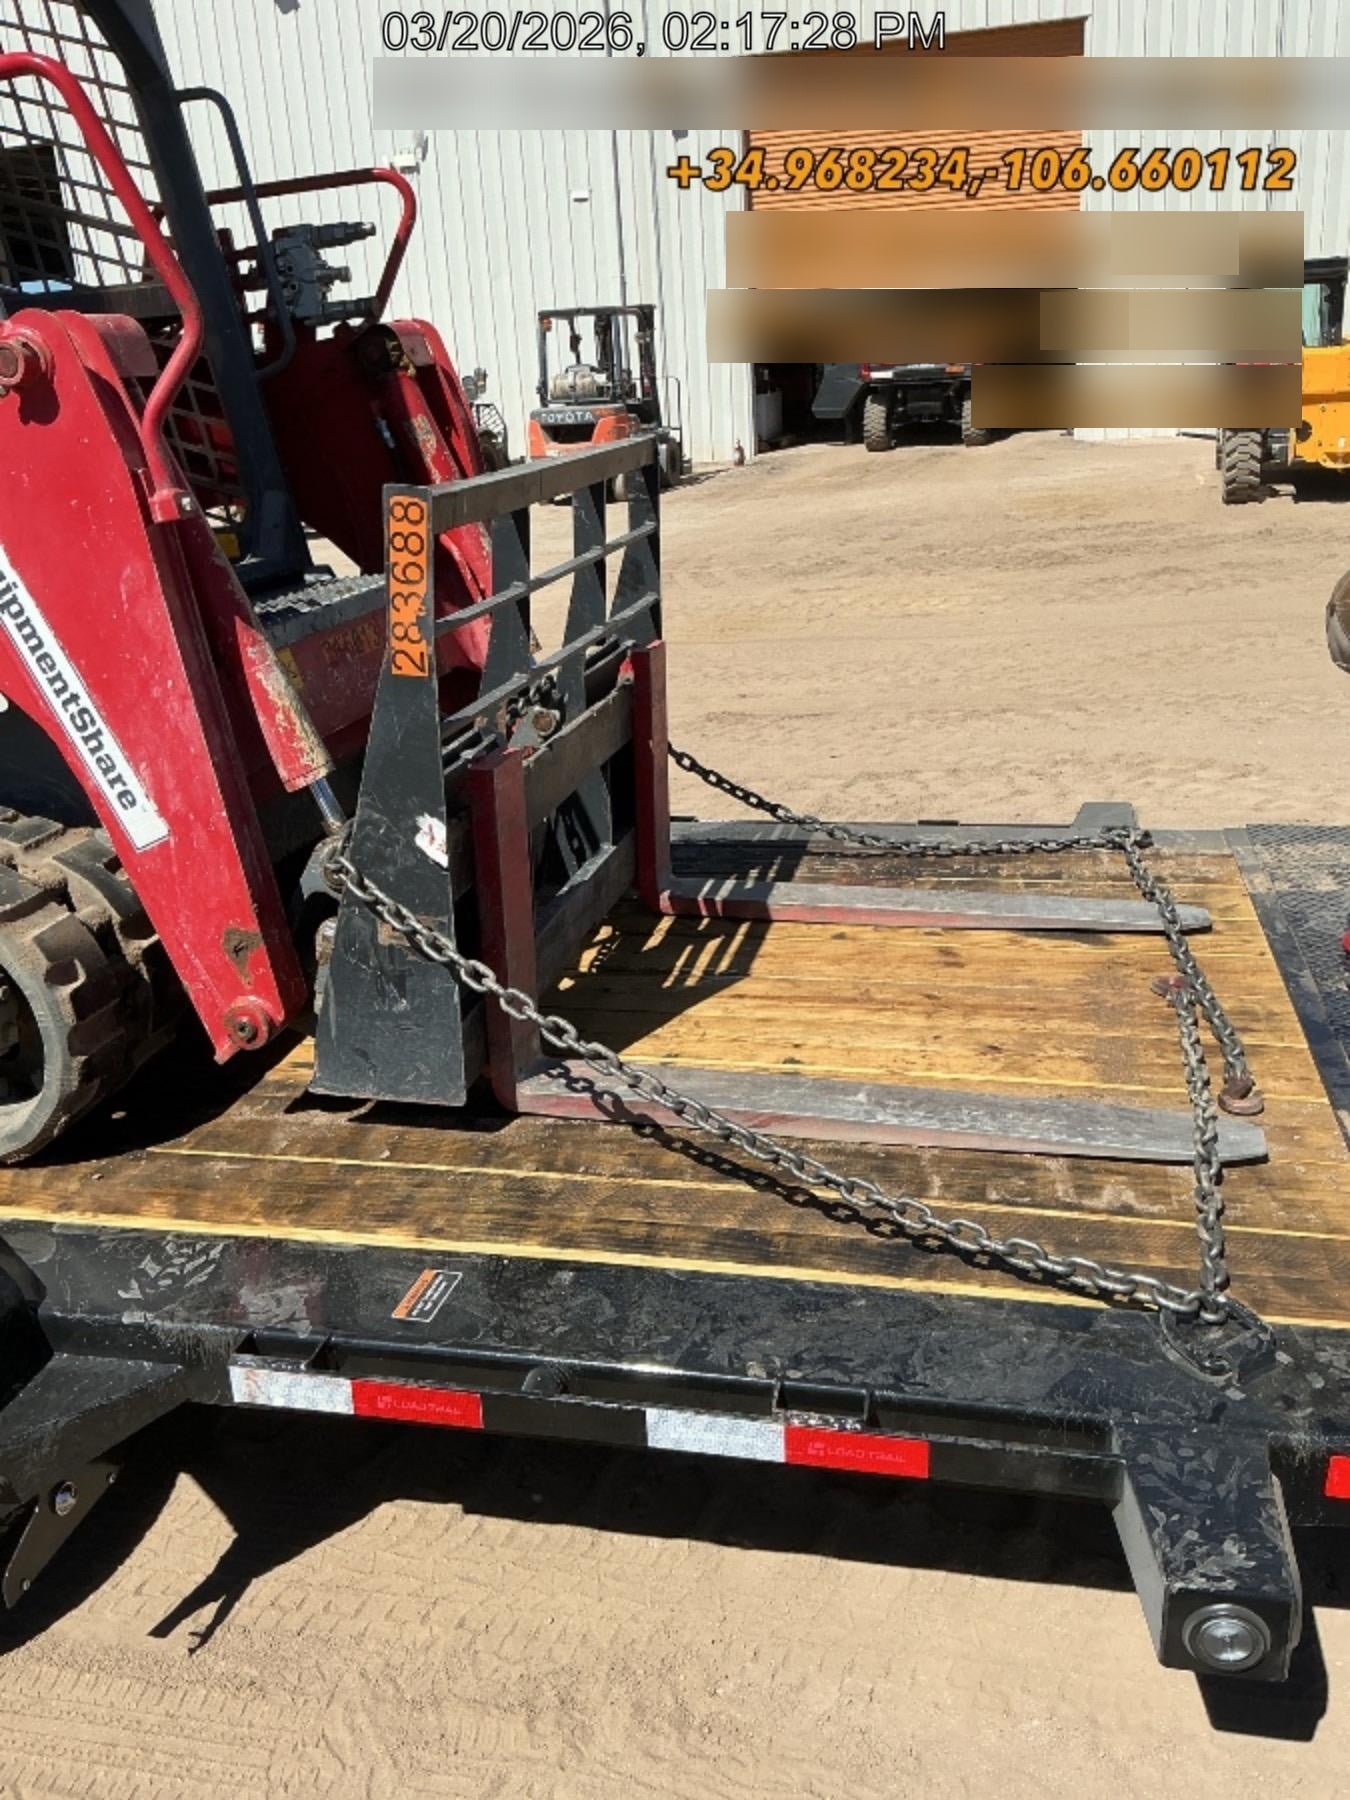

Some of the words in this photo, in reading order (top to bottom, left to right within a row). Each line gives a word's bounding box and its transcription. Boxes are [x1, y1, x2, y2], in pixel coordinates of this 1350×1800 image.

[541, 411, 595, 423] TOYOTA
[391, 501, 426, 674] 283688
[0, 569, 137, 811] ipmentShare
